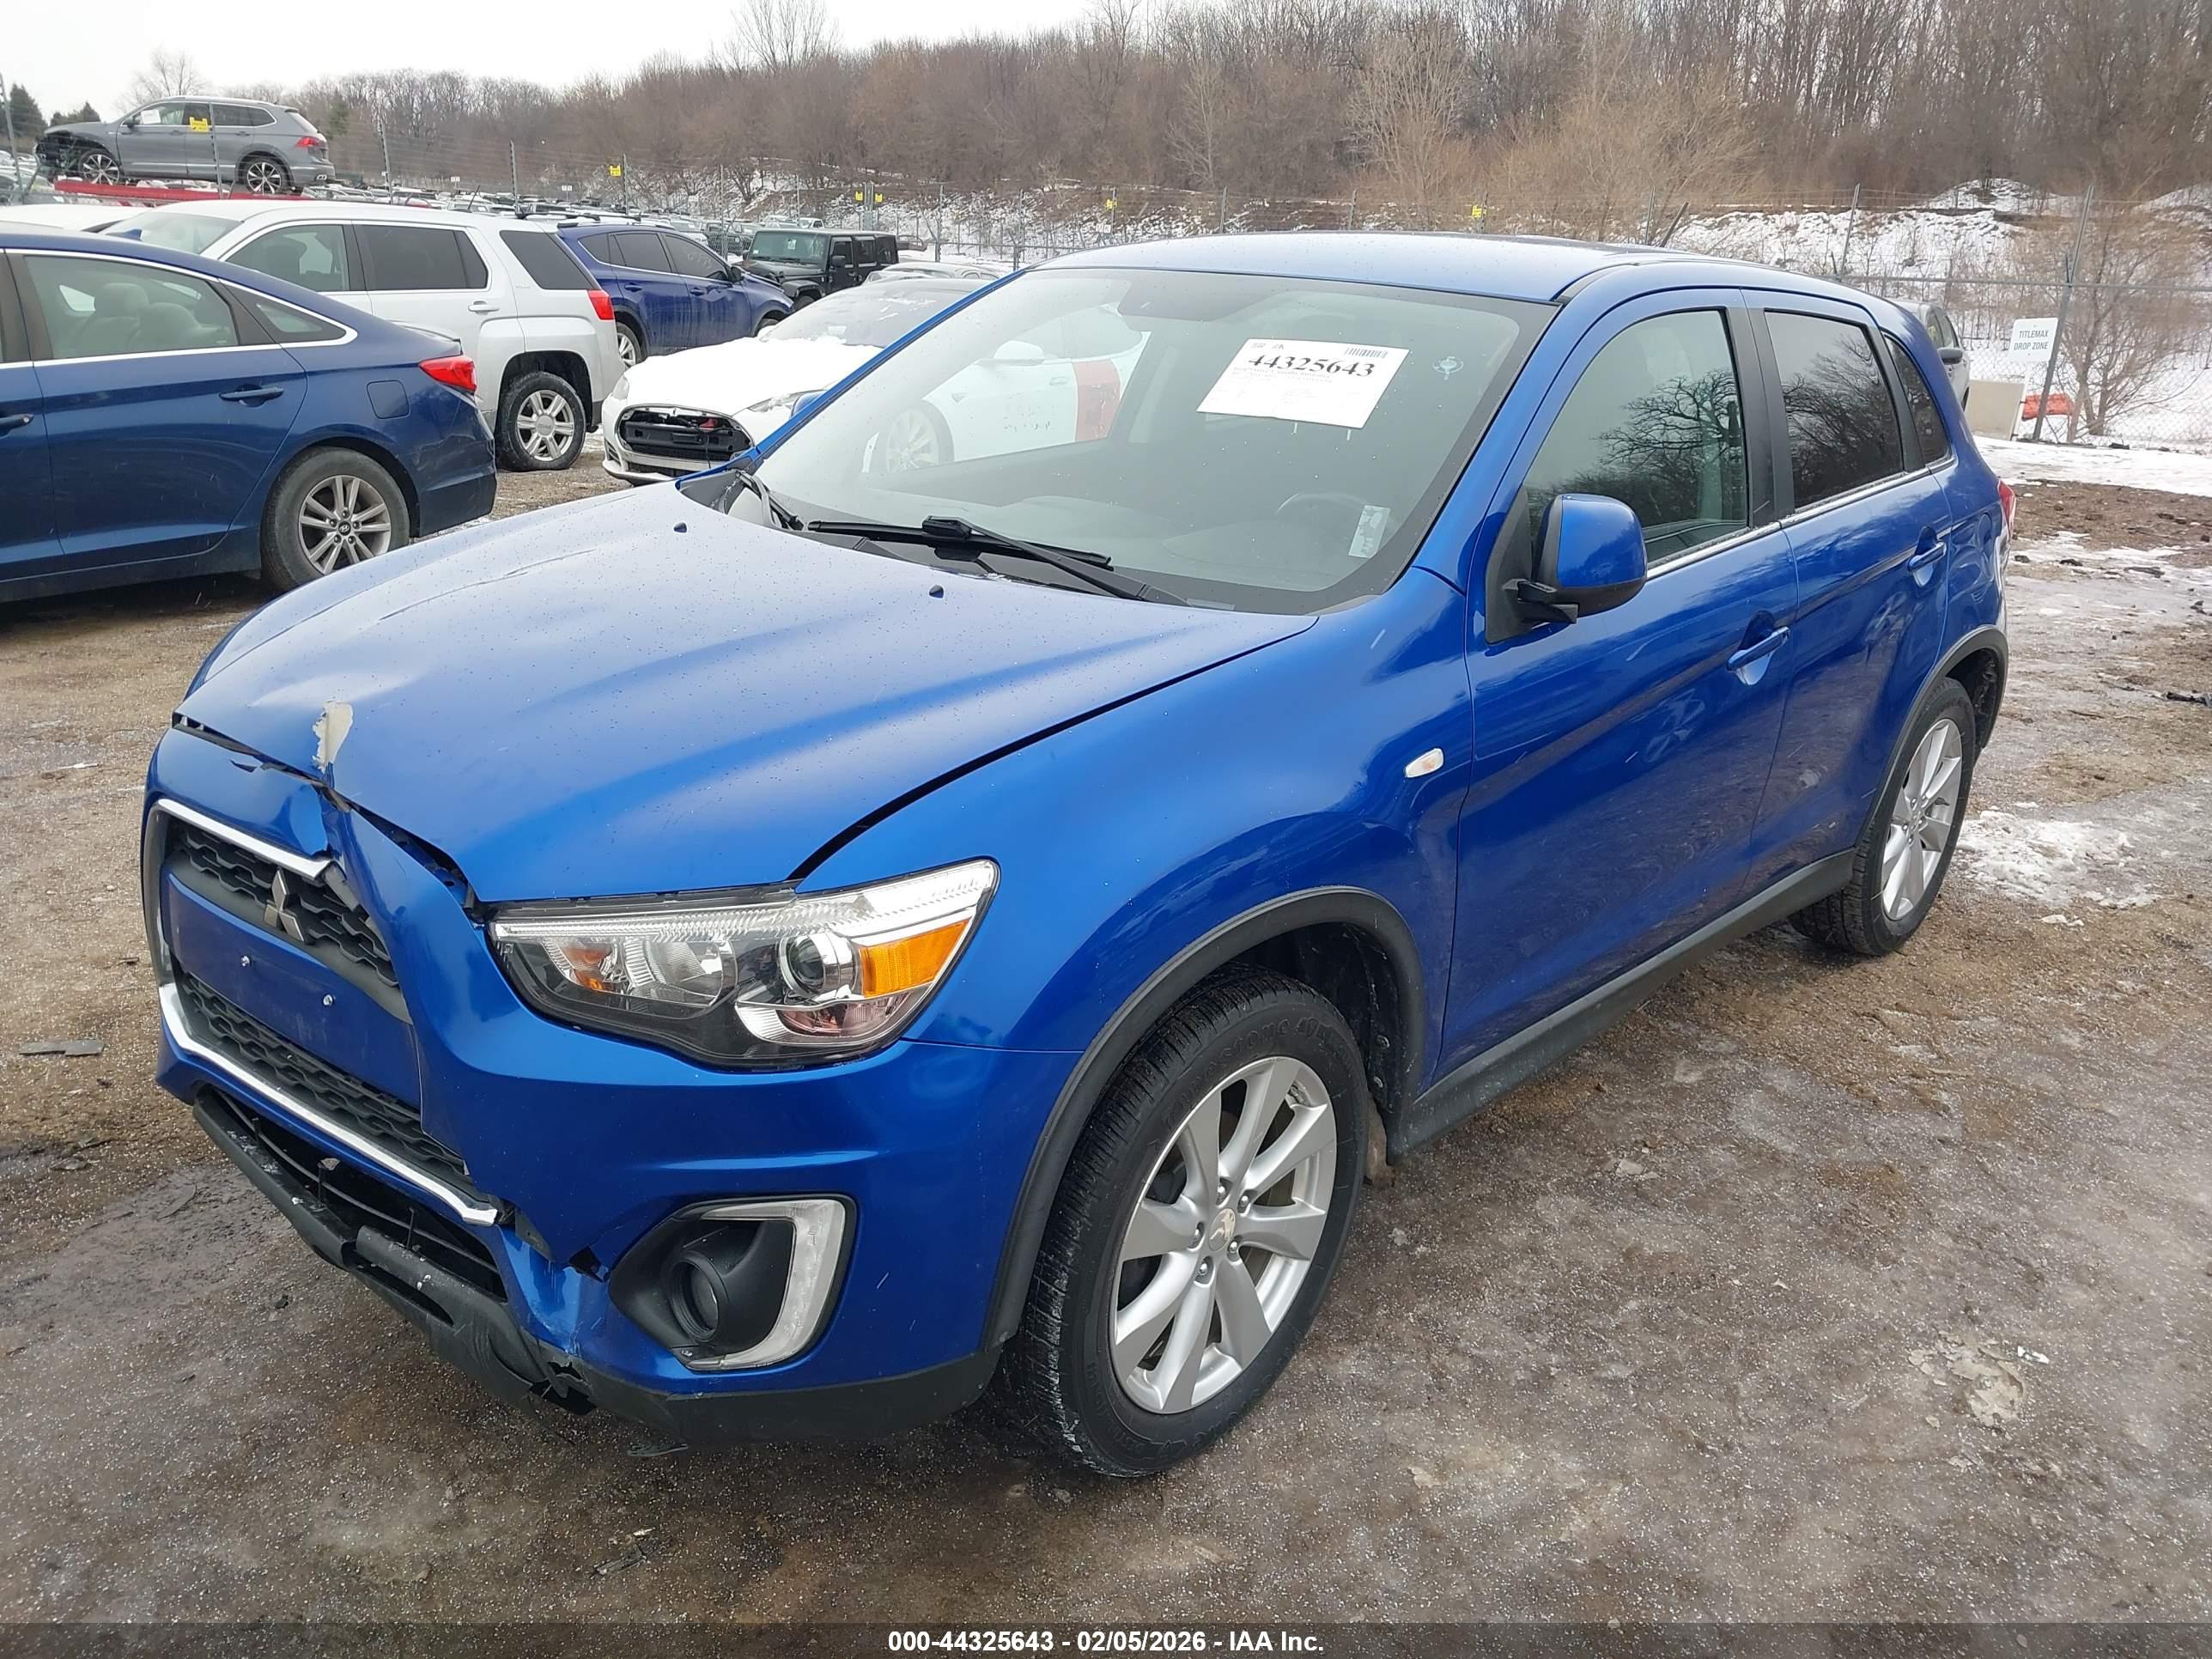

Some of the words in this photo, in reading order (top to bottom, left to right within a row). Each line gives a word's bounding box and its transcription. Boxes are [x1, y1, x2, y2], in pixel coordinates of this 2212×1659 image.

[2019, 330, 2049, 338] TITLEMAX
[2014, 342, 2032, 350] DROP
[2032, 342, 2049, 350] ZONE
[1248, 354, 1376, 377] 44325643
